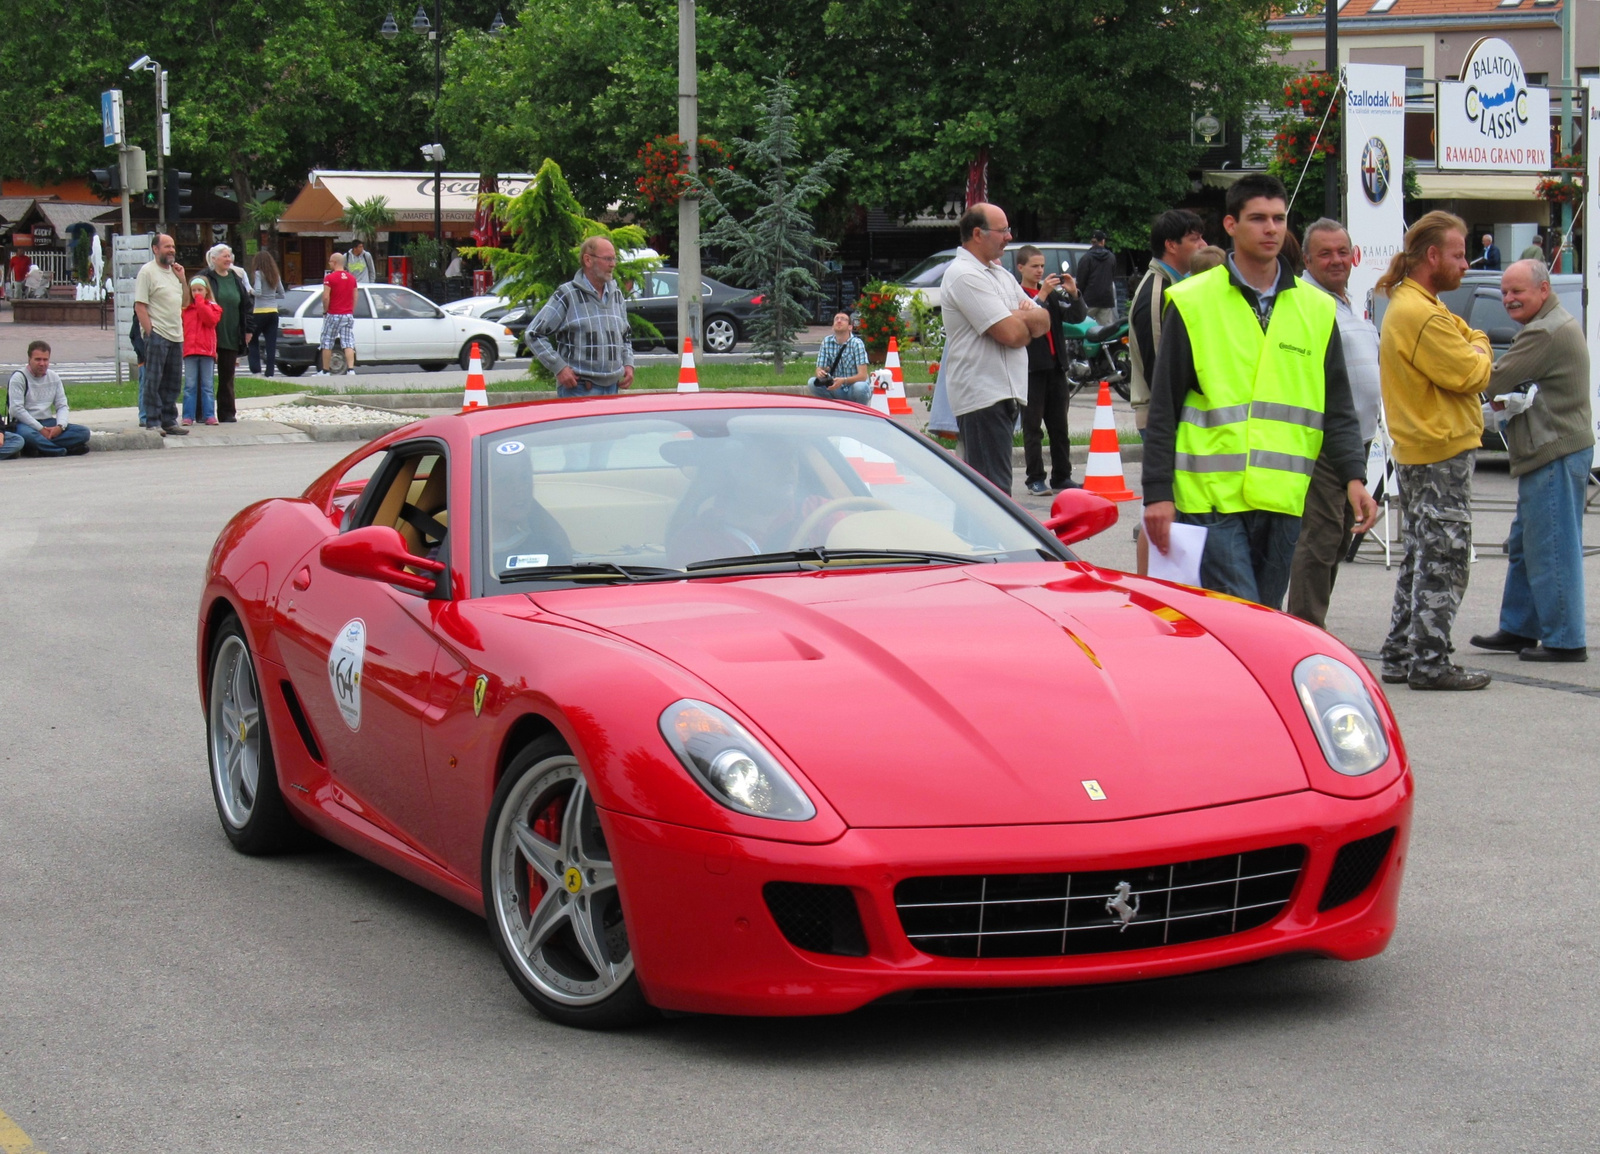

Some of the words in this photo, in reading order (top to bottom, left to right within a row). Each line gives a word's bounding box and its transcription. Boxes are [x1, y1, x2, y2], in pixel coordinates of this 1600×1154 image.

[1473, 56, 1519, 81] BALATON
[1446, 146, 1488, 163] RAMADA
[1490, 147, 1524, 164] GRAND
[1526, 148, 1546, 165] PRIX
[1363, 244, 1400, 258] RAMADA
[335, 657, 355, 704] 64
